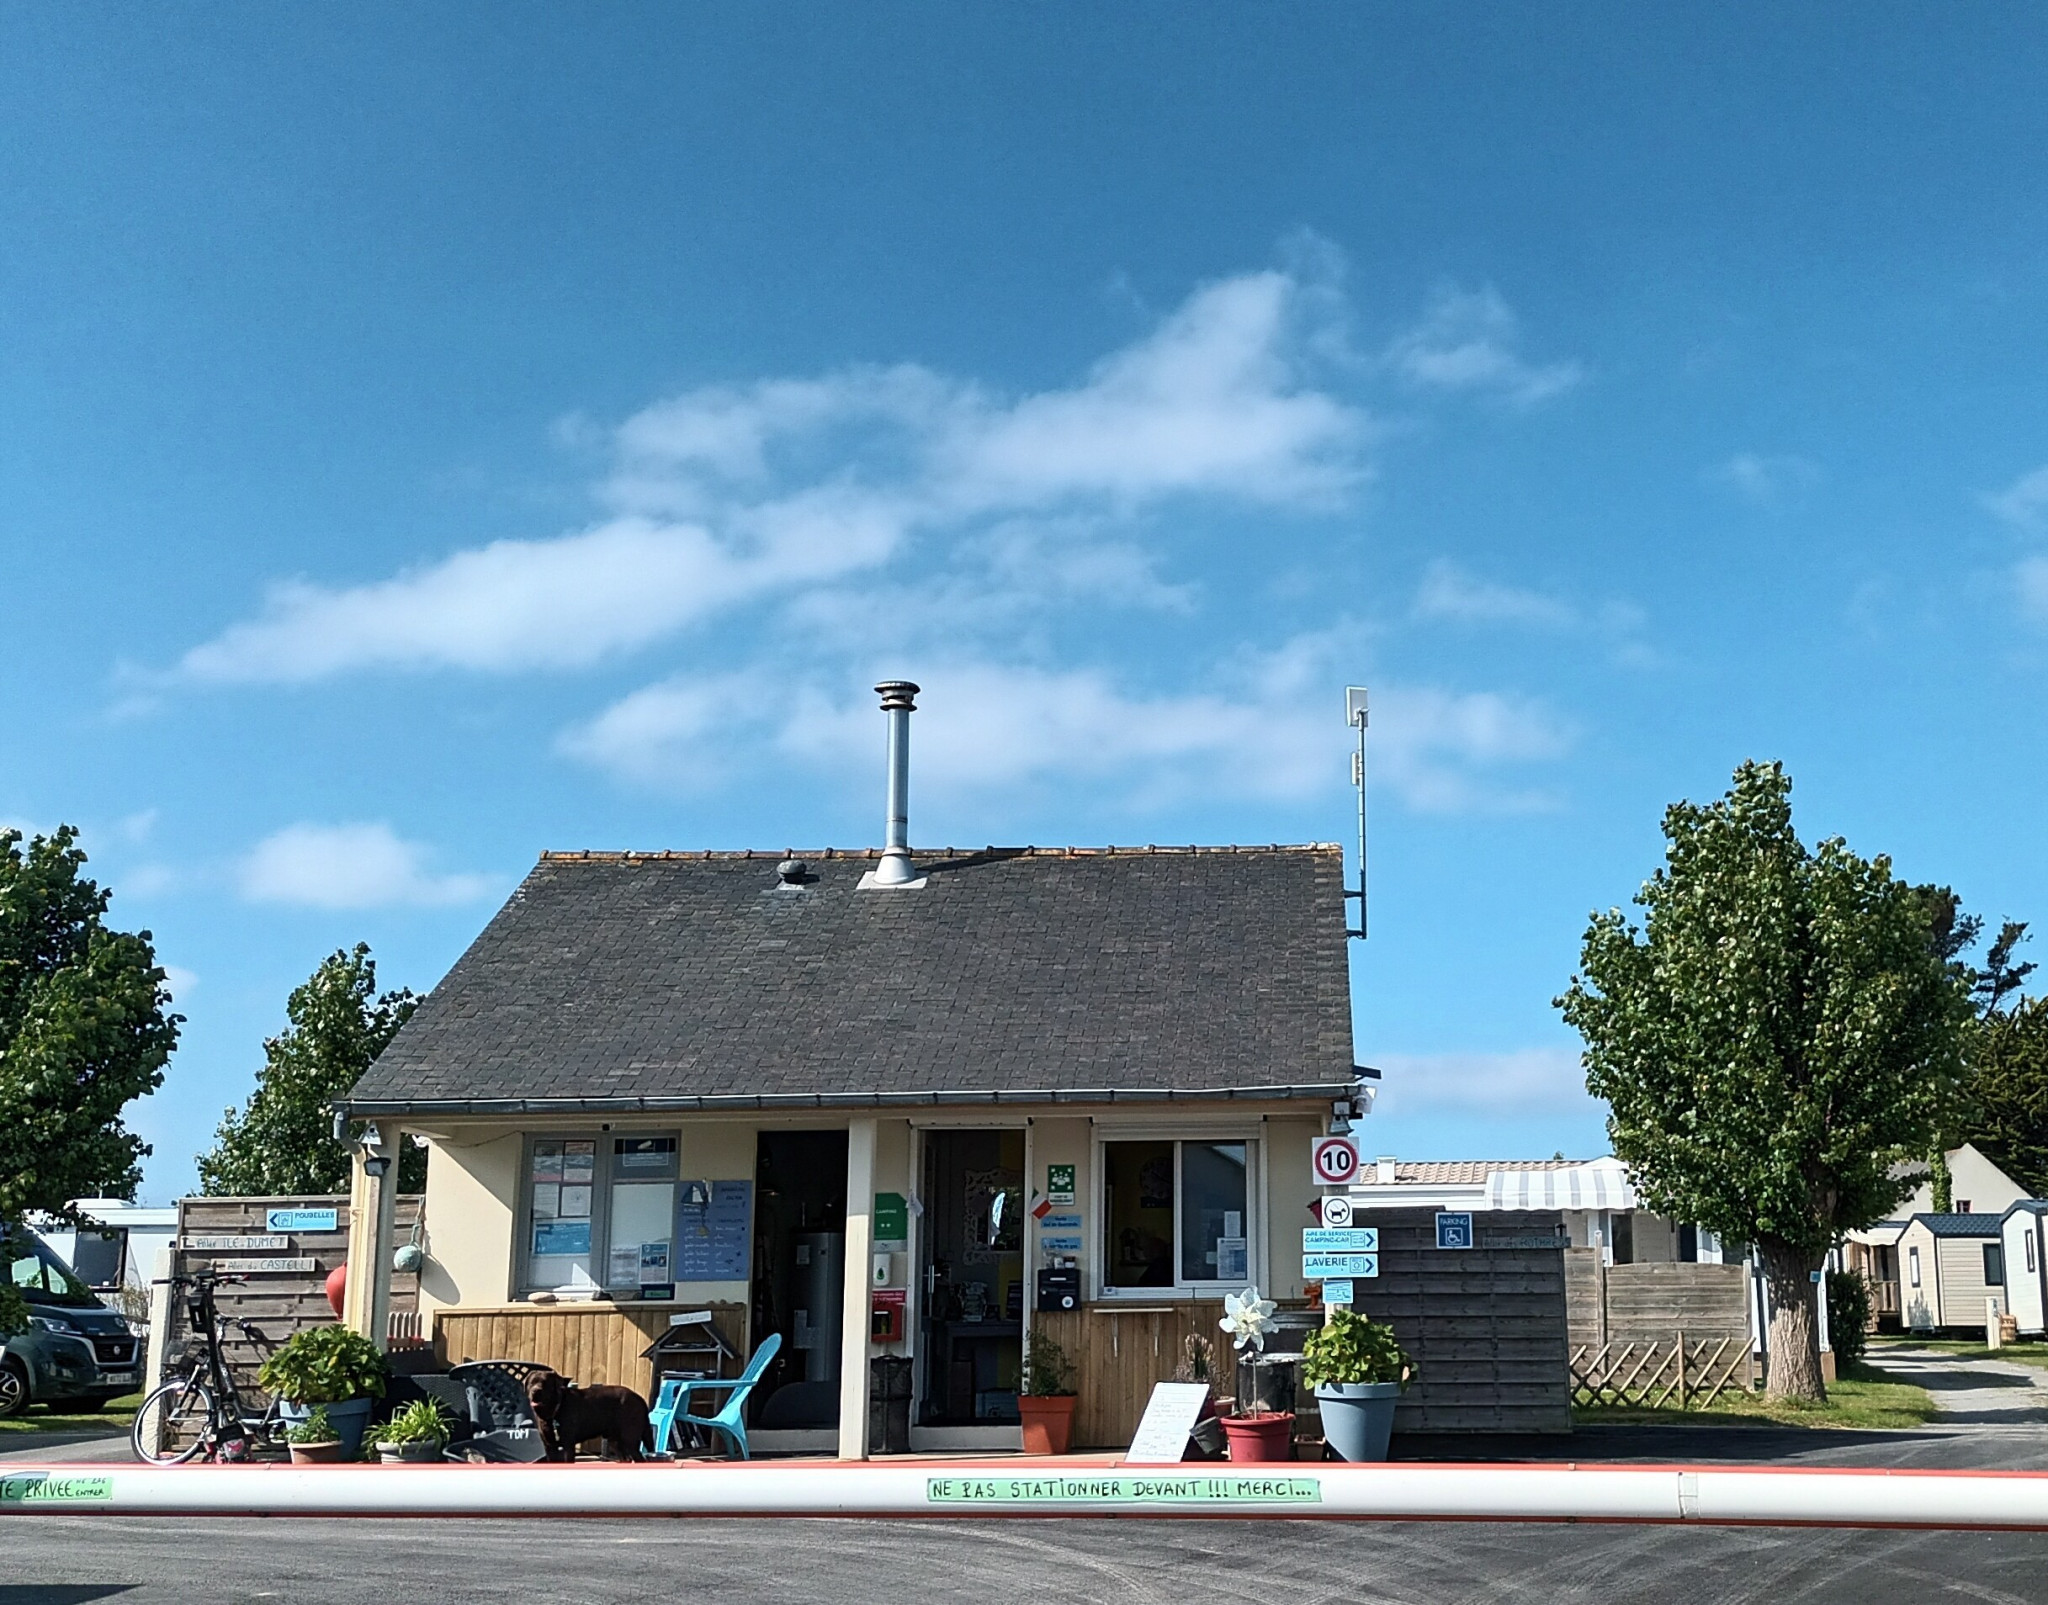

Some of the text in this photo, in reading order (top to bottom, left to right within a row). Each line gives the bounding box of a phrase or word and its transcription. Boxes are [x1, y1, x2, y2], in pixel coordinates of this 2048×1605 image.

[1322, 1150, 1350, 1171] 10
[1305, 1257, 1348, 1267] LAVERIE
[506, 1428, 529, 1440] TOM
[933, 1481, 951, 1497] NE
[962, 1481, 996, 1498] PAS
